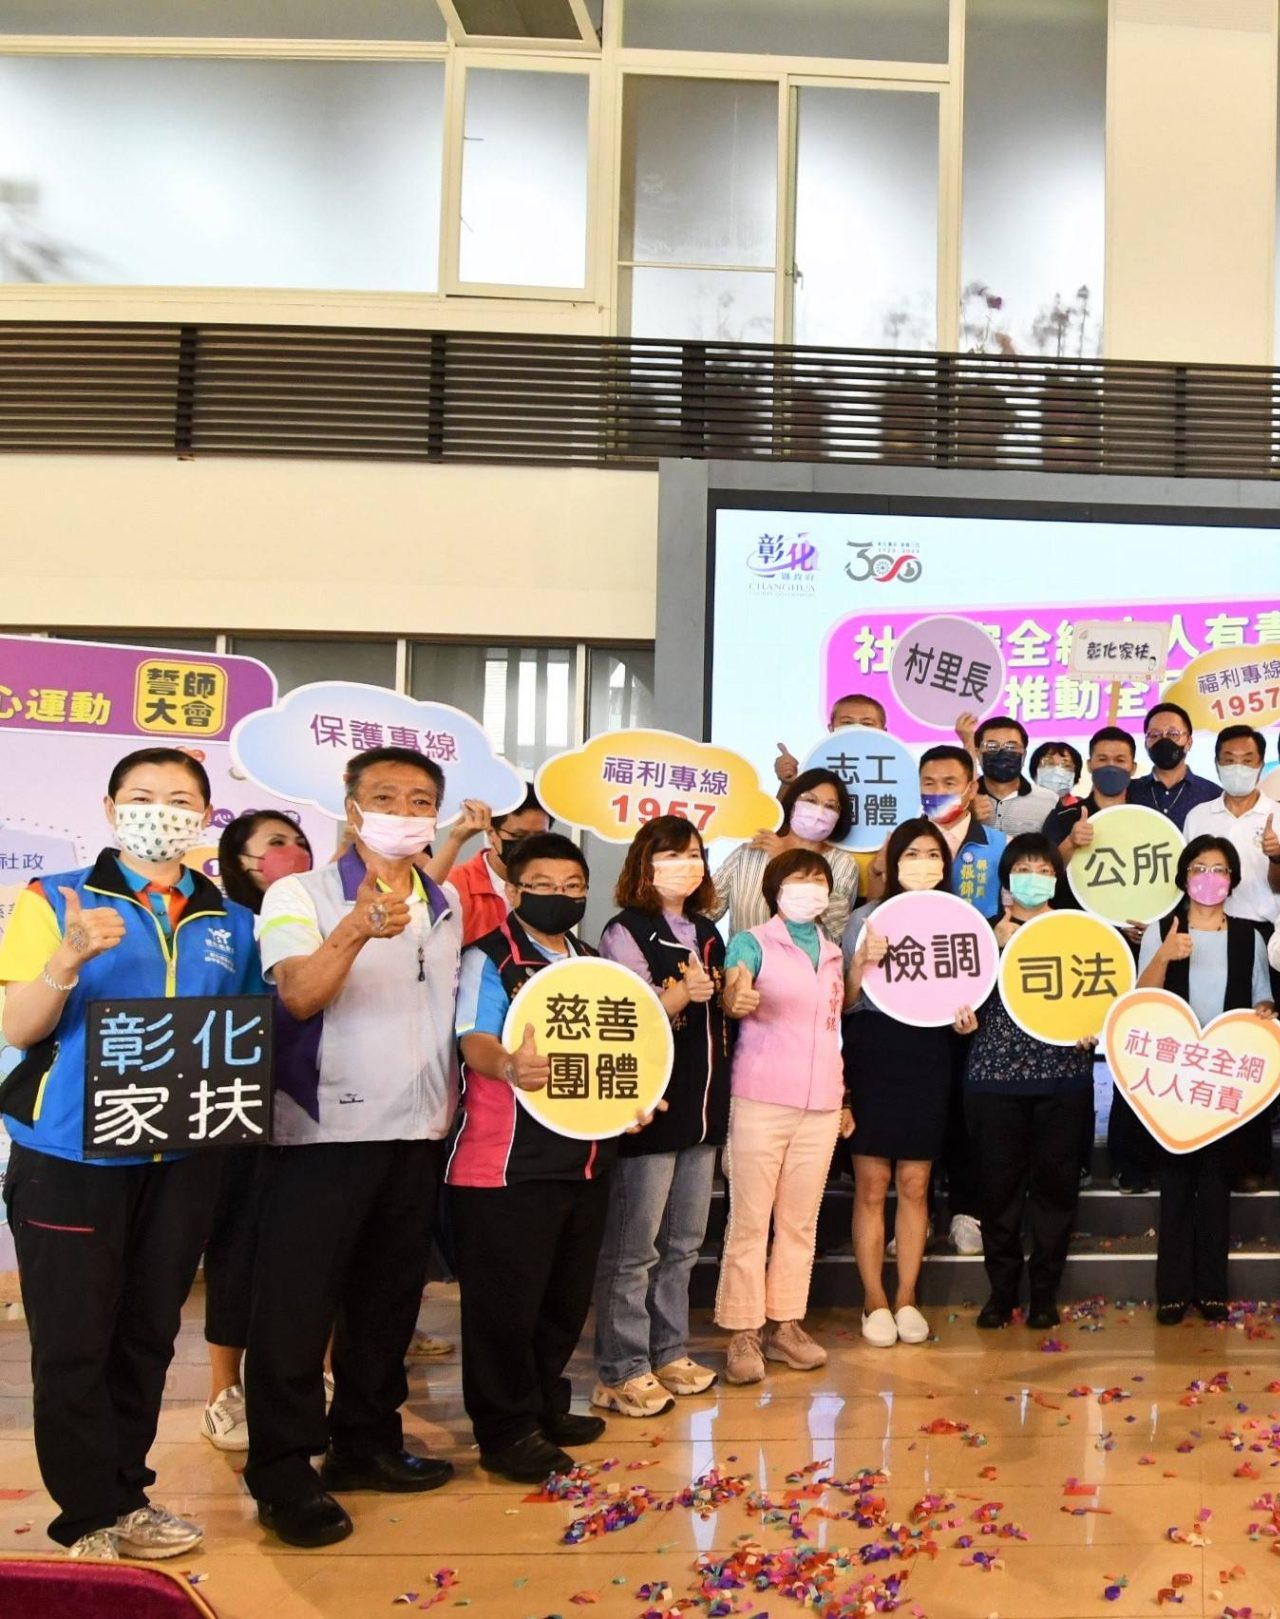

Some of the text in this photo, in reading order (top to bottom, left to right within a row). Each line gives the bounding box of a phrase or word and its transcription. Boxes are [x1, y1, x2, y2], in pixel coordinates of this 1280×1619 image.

[757, 532, 816, 571] 彰化
[904, 641, 992, 703] 村里長
[1087, 641, 1150, 660] 彰化家扶
[146, 667, 217, 698] 誓師
[144, 698, 216, 728] 大會
[309, 713, 458, 762] 保護專線
[602, 757, 729, 796] 福利專線
[826, 752, 898, 785] 志工
[1083, 842, 1174, 888] 公所
[878, 932, 981, 984] 檢調
[1018, 952, 1118, 1001] 司法
[99, 1009, 262, 1075] 彰化
[545, 993, 638, 1042] 慈善
[547, 1053, 639, 1101] 團體
[1124, 1028, 1267, 1085] 社會安全網
[93, 1077, 264, 1146] 家扶
[1129, 1065, 1244, 1116] 人人有責
